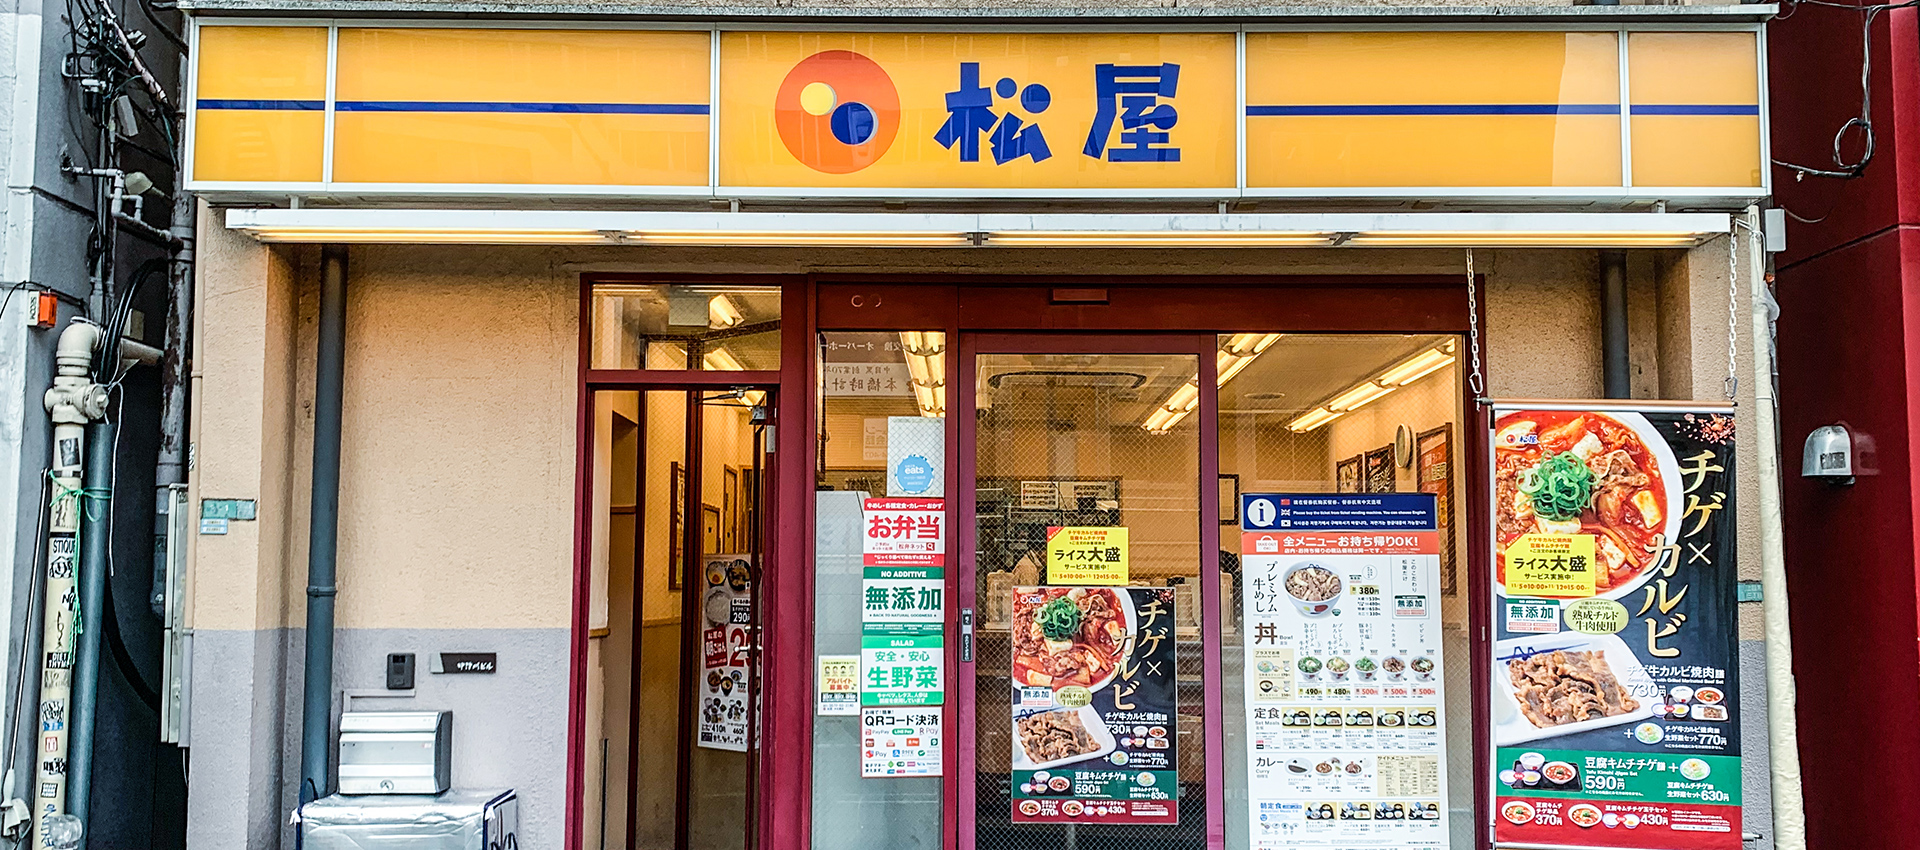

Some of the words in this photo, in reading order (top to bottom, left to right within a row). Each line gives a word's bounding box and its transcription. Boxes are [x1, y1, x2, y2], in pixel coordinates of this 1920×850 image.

[934, 62, 1181, 166] 松屋
[904, 466, 925, 475] eats
[1679, 449, 1727, 565] チゲ×
[868, 515, 939, 540] お弁当
[1283, 535, 1418, 547] 全メニューお持ち帰りOK!
[1054, 546, 1121, 563] ライス大盛
[1513, 555, 1587, 573] ライス大盛
[1267, 560, 1278, 612] プレミアム
[1359, 586, 1380, 595] 380円
[865, 586, 941, 611] 無添加
[1252, 578, 1266, 613] 牛めし
[1636, 533, 1688, 657] カルビ
[1397, 600, 1423, 608] 無添加
[1510, 605, 1554, 619] 無添加
[1572, 610, 1619, 621] 熟成チルド
[1575, 621, 1616, 631] 牛肉使用
[1137, 599, 1170, 677] チゲ×
[1254, 622, 1278, 645] 丼
[875, 651, 930, 662] 安全・安心
[1108, 627, 1142, 711] カルビ
[867, 666, 938, 689] 生野菜
[1024, 690, 1050, 698] 無添加
[1254, 707, 1280, 719] 定食
[865, 714, 939, 727] QRコード決済
[1105, 724, 1131, 735] 730円
[1698, 734, 1727, 745] 770円
[1151, 757, 1169, 765] 770円
[1256, 757, 1284, 767] カレー
[1075, 784, 1101, 794] 590円
[1585, 776, 1625, 790] 590円
[1701, 790, 1729, 801] 630円
[1041, 808, 1059, 816] 370円
[1108, 806, 1126, 814] 430円
[1535, 814, 1563, 826] 370円
[1640, 814, 1669, 825] 430円
